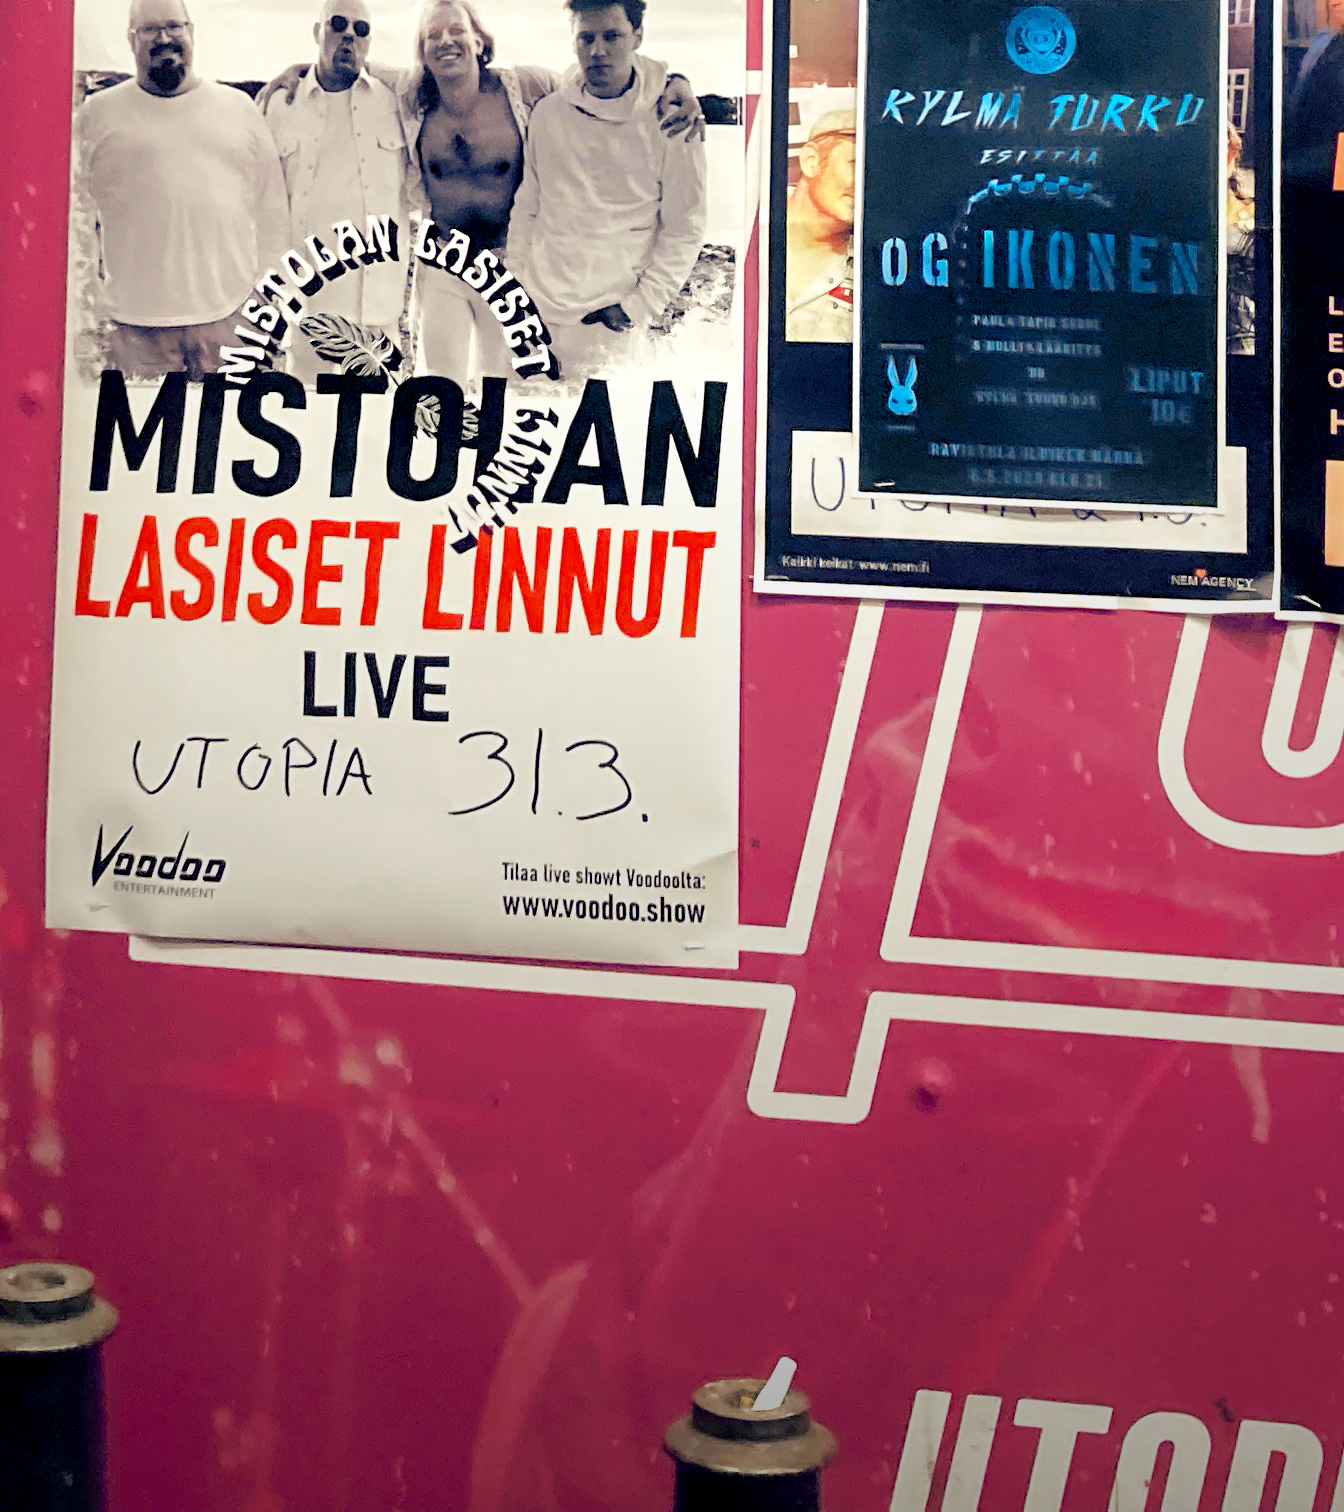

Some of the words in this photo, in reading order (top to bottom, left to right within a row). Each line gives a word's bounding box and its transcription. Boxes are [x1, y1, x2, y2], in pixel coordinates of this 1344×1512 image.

[881, 84, 1026, 128] KYLMÄ
[1048, 94, 1206, 133] TURKU
[881, 231, 951, 288] OG
[982, 229, 1201, 295] IKONEN
[218, 214, 399, 389] MISTOLAN
[411, 217, 561, 381] LASISET
[74, 512, 401, 627] LASISET
[421, 522, 717, 639] LINNUT
[1201, 575, 1255, 589] AGENCY
[302, 650, 451, 722] LIVE
[132, 735, 373, 797] UTOPIA
[447, 727, 650, 823] 31.3.
[90, 823, 227, 887] Voodoo
[501, 861, 539, 883] Tilaa
[543, 863, 572, 885] live
[576, 865, 622, 887] showt
[625, 866, 706, 890] Voodoolta:
[113, 880, 216, 900] ENTERTAINMENT
[503, 894, 706, 924] www.voodoo.show
